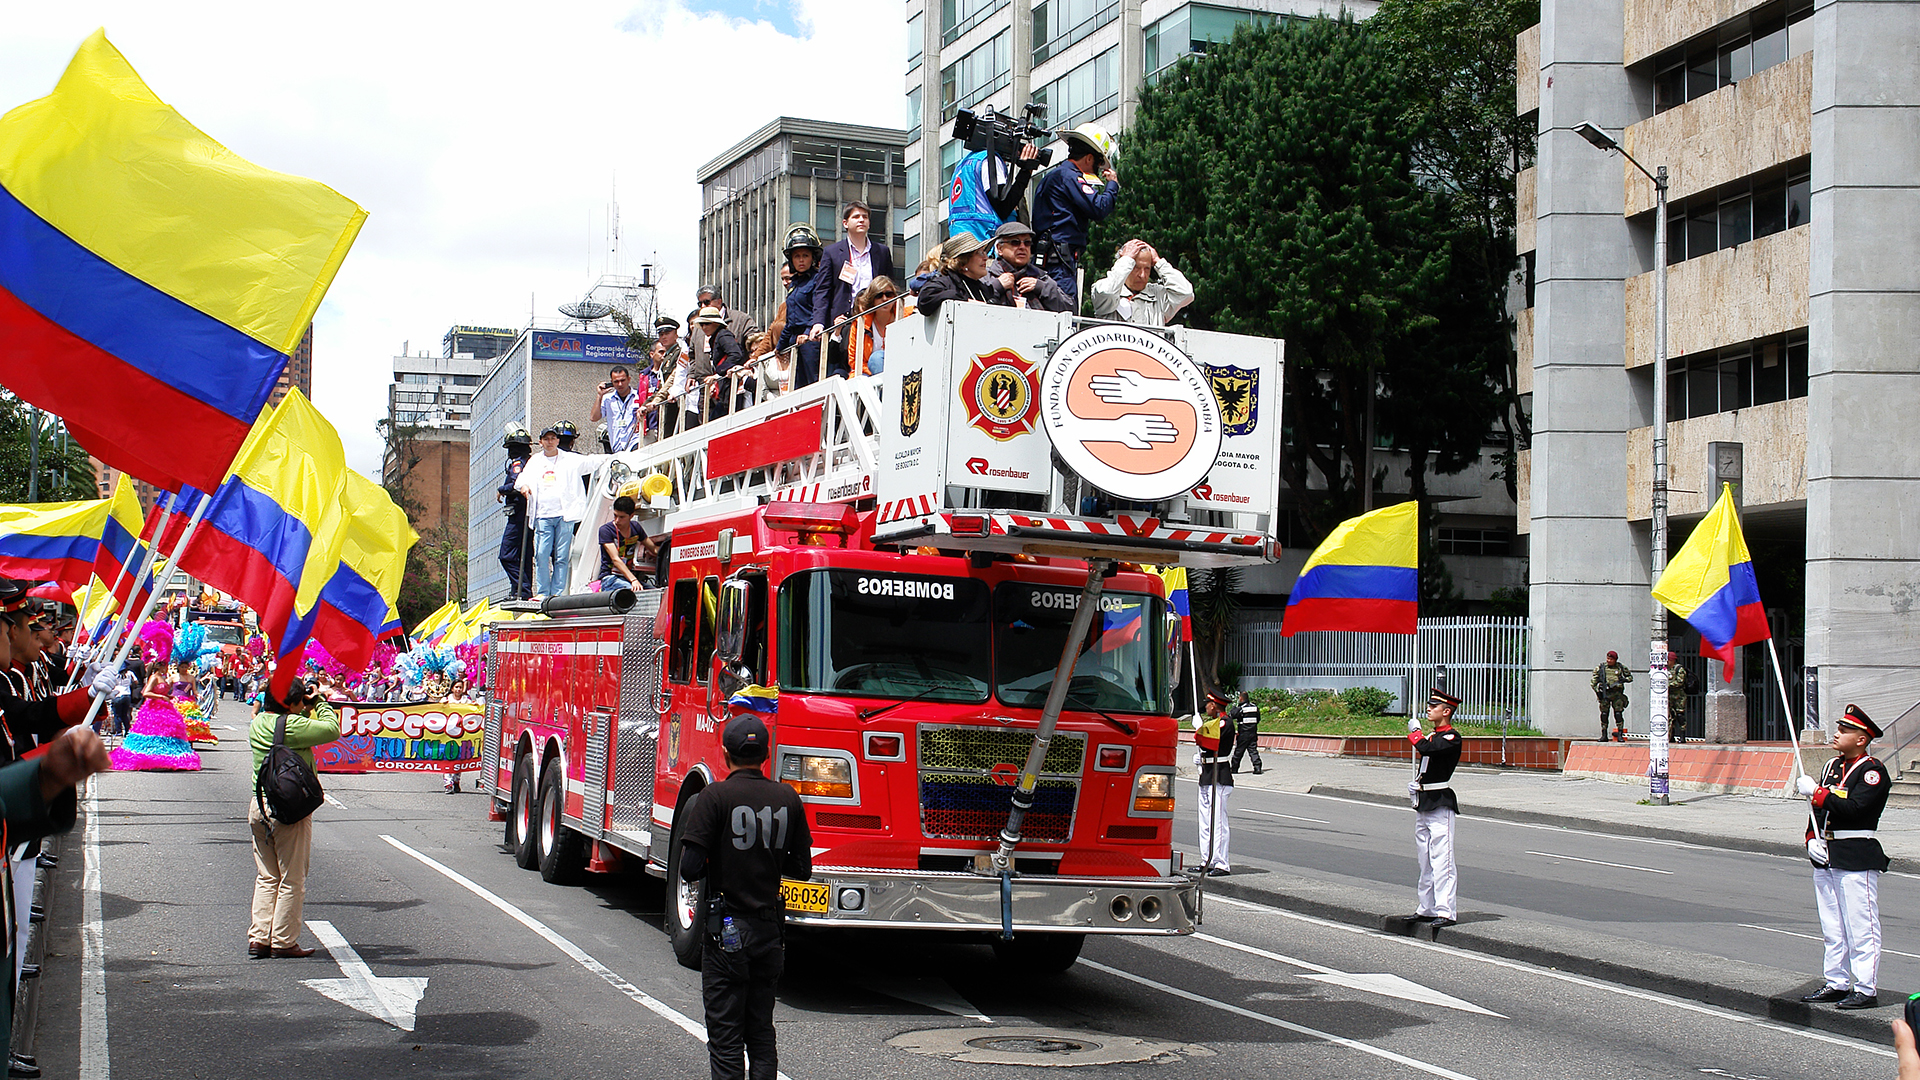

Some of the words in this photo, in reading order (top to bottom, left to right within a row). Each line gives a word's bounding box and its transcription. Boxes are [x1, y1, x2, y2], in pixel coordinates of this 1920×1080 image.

[460, 325, 513, 335] TELESENTINEL
[551, 339, 582, 351] CAR
[1050, 354, 1073, 428] FUNDACION
[1070, 332, 1155, 357] SOLIDARIDAD
[1157, 346, 1183, 369] POR
[1182, 369, 1213, 434] COLOMBIA
[989, 467, 1030, 479] rosenbauer
[828, 479, 861, 500] rosenbauer
[1213, 492, 1251, 503] rosenbauer
[680, 546, 700, 559] BOMBEROS
[700, 544, 716, 556] BOGOTA
[341, 706, 484, 739] FROCOLO
[374, 736, 482, 760] FOLCLORI
[375, 761, 442, 771] COROZAL
[453, 760, 482, 770] SUCR
[731, 805, 788, 850] 911
